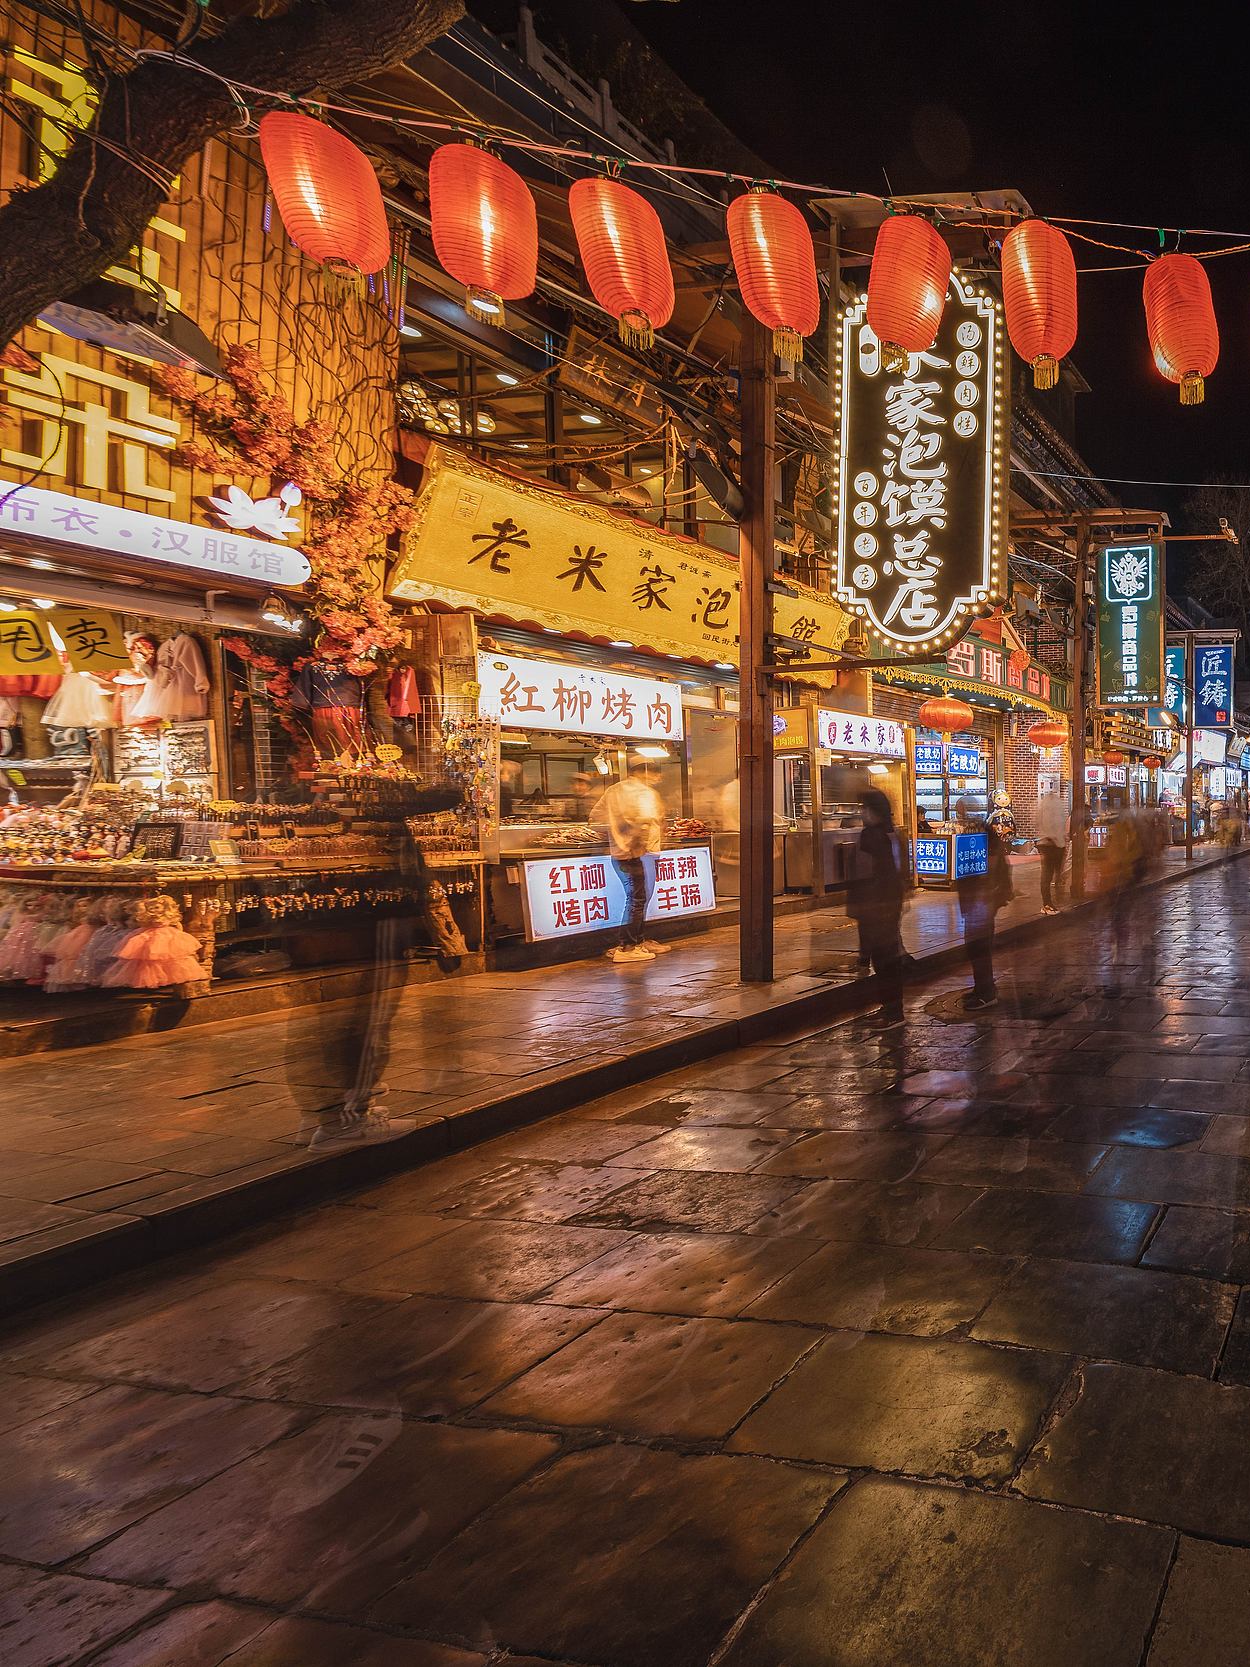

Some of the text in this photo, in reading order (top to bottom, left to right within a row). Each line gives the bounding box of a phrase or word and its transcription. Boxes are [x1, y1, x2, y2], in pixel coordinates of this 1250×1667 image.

[955, 325, 978, 433] 汤鲜肉烂
[855, 477, 874, 586] 百年老店
[916, 746, 941, 760] 老酸奶
[950, 752, 978, 772] 老酸奶
[917, 841, 945, 857] 老酸奶
[548, 863, 607, 895] 红柳
[655, 855, 699, 882] 麻辣
[657, 883, 702, 911] 羊蹄
[553, 896, 609, 929] 烤肉
